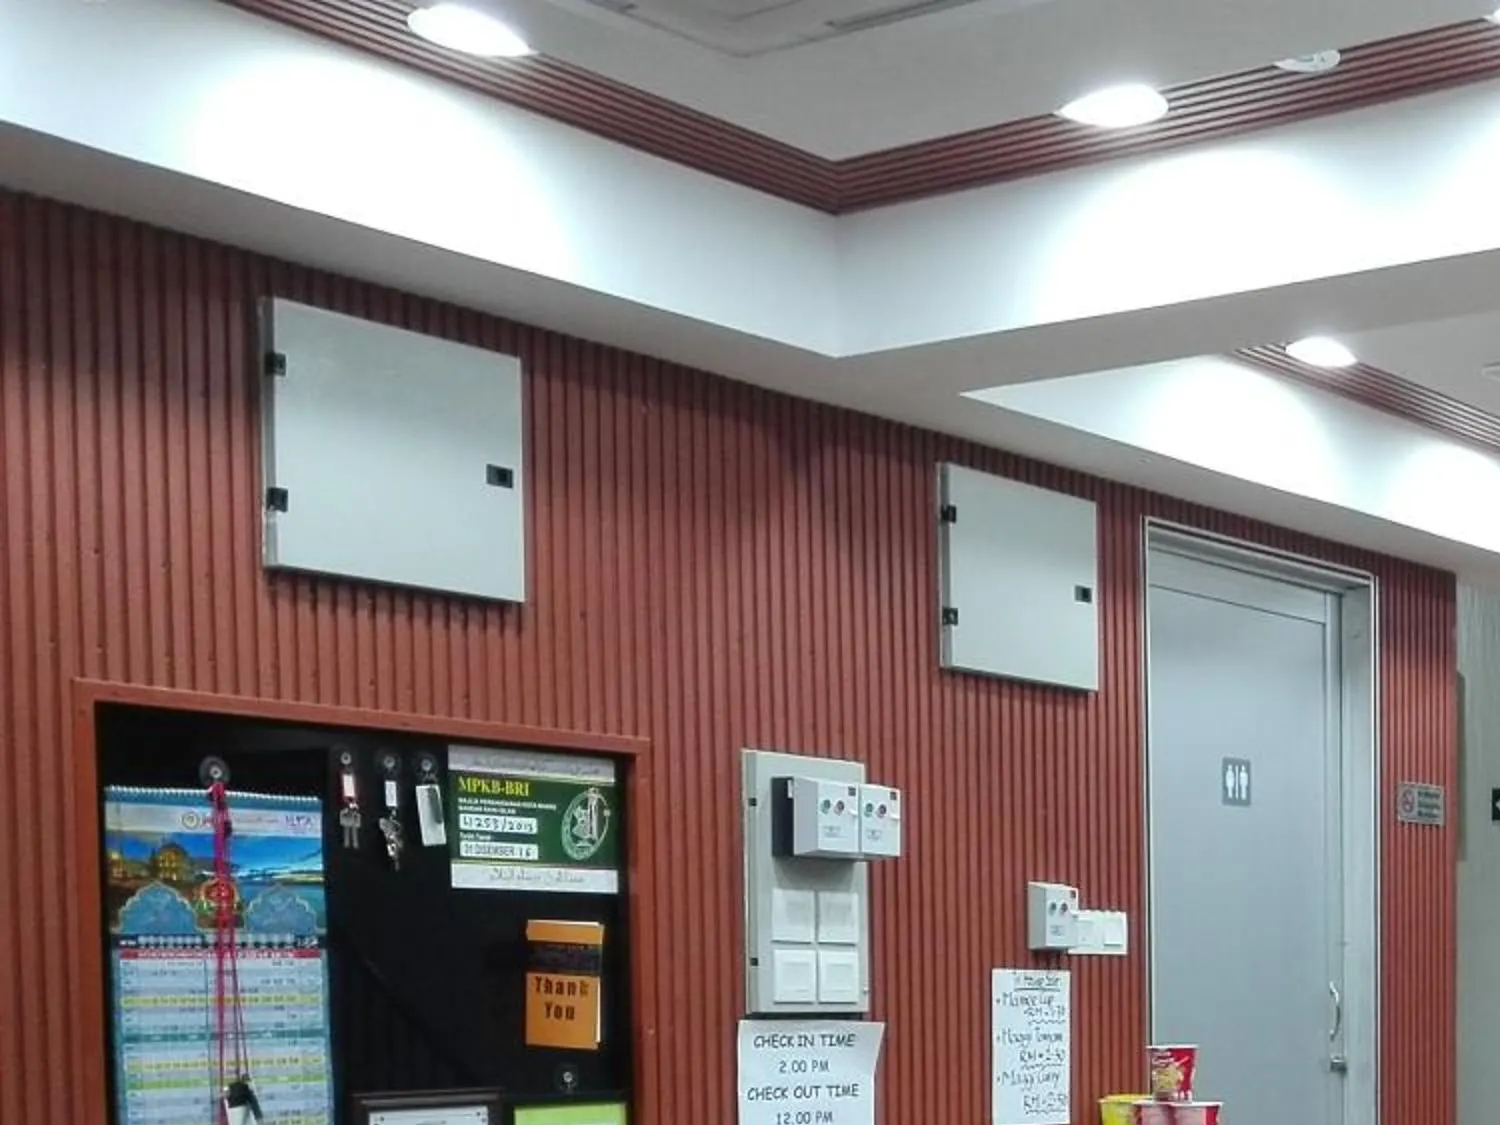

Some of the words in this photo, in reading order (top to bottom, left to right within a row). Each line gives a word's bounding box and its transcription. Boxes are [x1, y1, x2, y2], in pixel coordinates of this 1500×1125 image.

[458, 776, 530, 797] MPKB-BRI
[544, 1001, 576, 1021] You
[753, 1034, 795, 1049] CHECK
[797, 1034, 815, 1048] IN
[820, 1033, 856, 1047] TIME
[811, 1059, 830, 1073] PM
[747, 1086, 789, 1101] CHECK
[793, 1085, 822, 1099] OUT
[825, 1083, 860, 1098] TIME
[815, 1110, 833, 1123] PM
